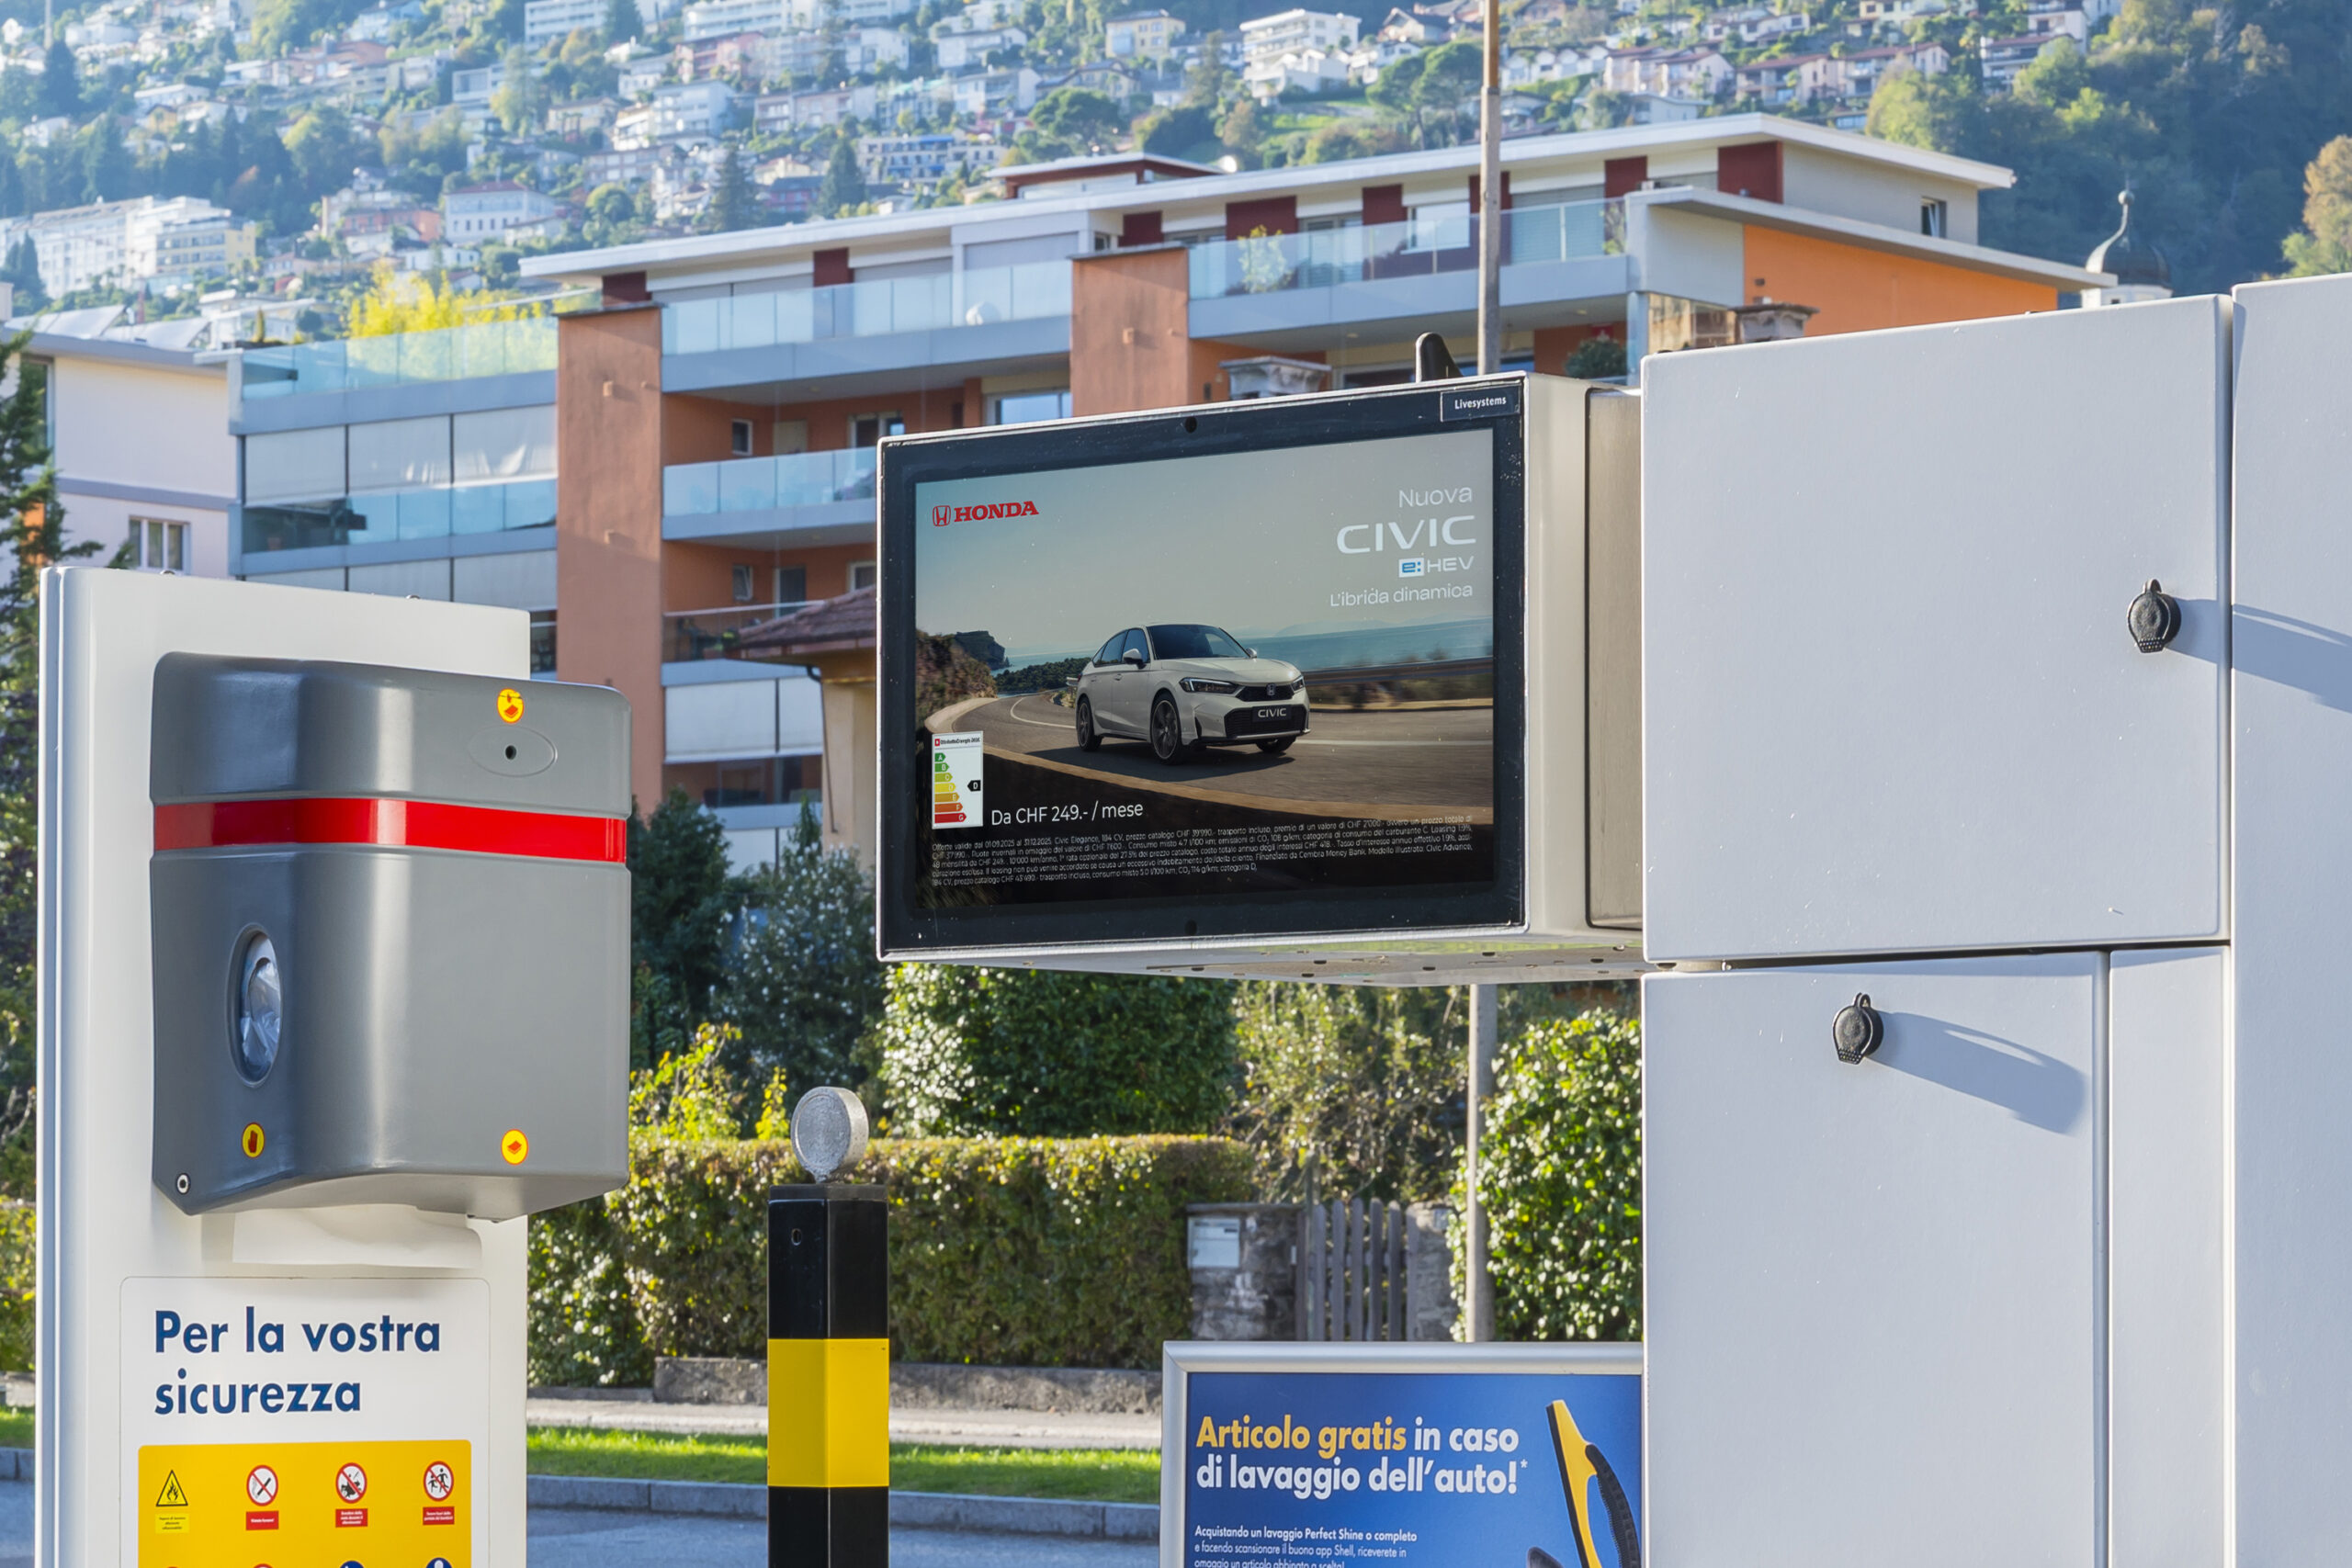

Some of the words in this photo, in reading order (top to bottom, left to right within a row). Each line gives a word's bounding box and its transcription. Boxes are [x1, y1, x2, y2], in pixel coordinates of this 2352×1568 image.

[1454, 396, 1507, 410] Livesystems
[1398, 487, 1473, 508] Nuova
[954, 501, 1039, 523] HONDA
[1337, 515, 1476, 554] CIVIC
[1330, 588, 1389, 606] L'ibrida
[1393, 583, 1473, 603] dinamica
[1258, 707, 1287, 718] CIVIC
[991, 809, 1012, 825] Da
[1016, 806, 1048, 823] CHF
[1051, 803, 1089, 822] 249.-
[1102, 803, 1144, 818] mese
[155, 1310, 229, 1353] Per
[246, 1306, 285, 1353] la
[302, 1314, 440, 1353] vostra
[154, 1368, 361, 1415] sicurezza
[1196, 1415, 1311, 1450] Articolo
[1318, 1416, 1408, 1460] gratis
[1414, 1416, 1442, 1451] in
[1449, 1427, 1520, 1453] caso
[1196, 1454, 1223, 1489] di
[1230, 1454, 1362, 1501] lavaggio
[1194, 1525, 1250, 1540] Acquistando
[1250, 1529, 1262, 1538] un
[1264, 1526, 1303, 1542] lavaggio
[1305, 1527, 1337, 1540] Perfect
[1338, 1528, 1364, 1541] Shine
[1365, 1532, 1373, 1541] o
[1374, 1529, 1418, 1545] completo
[1194, 1544, 1201, 1552] e
[1201, 1540, 1233, 1553] facendo
[1235, 1543, 1281, 1554] scansionare
[1282, 1543, 1287, 1554] il
[1288, 1543, 1315, 1555] buono
[1315, 1546, 1332, 1559] app
[1334, 1544, 1356, 1559] Shell,
[1357, 1546, 1397, 1558] riceverete
[1398, 1547, 1407, 1558] in
